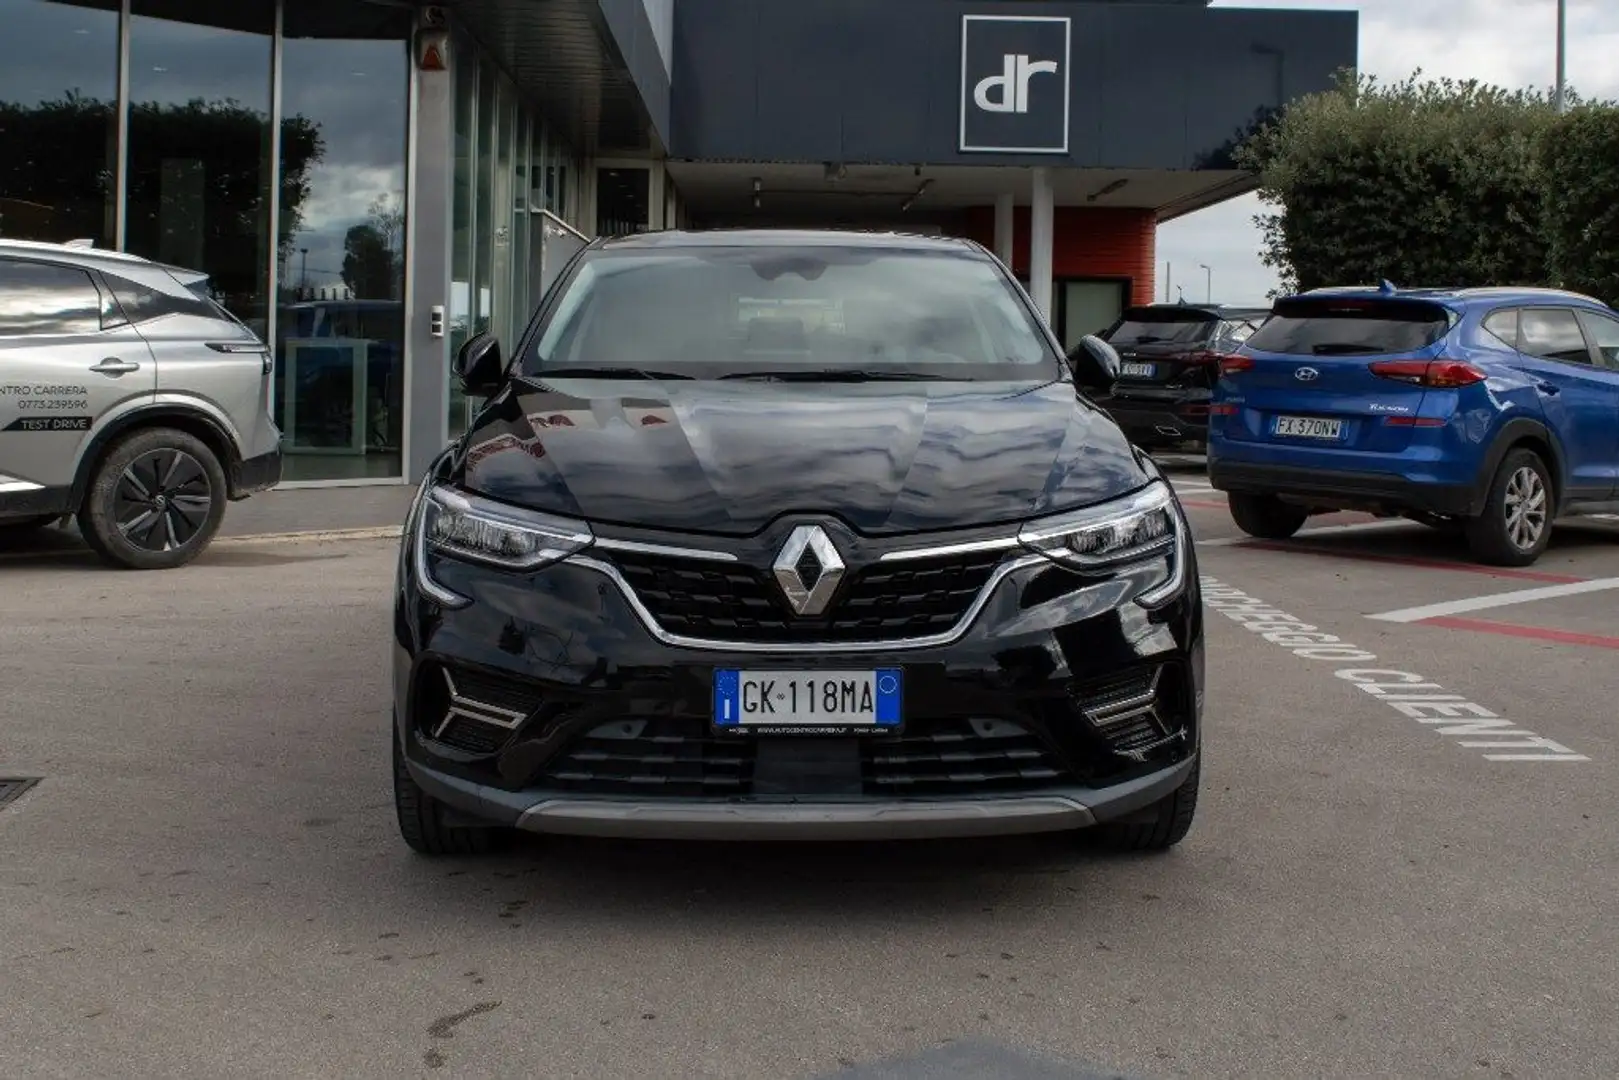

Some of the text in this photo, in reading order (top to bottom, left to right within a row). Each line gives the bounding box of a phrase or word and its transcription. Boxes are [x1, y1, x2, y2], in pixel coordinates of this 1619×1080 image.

[974, 54, 1058, 113] dr
[34, 386, 88, 395] CARRERA
[21, 420, 87, 430] TEST DRIVE
[1334, 668, 1592, 761] CLIENTI
